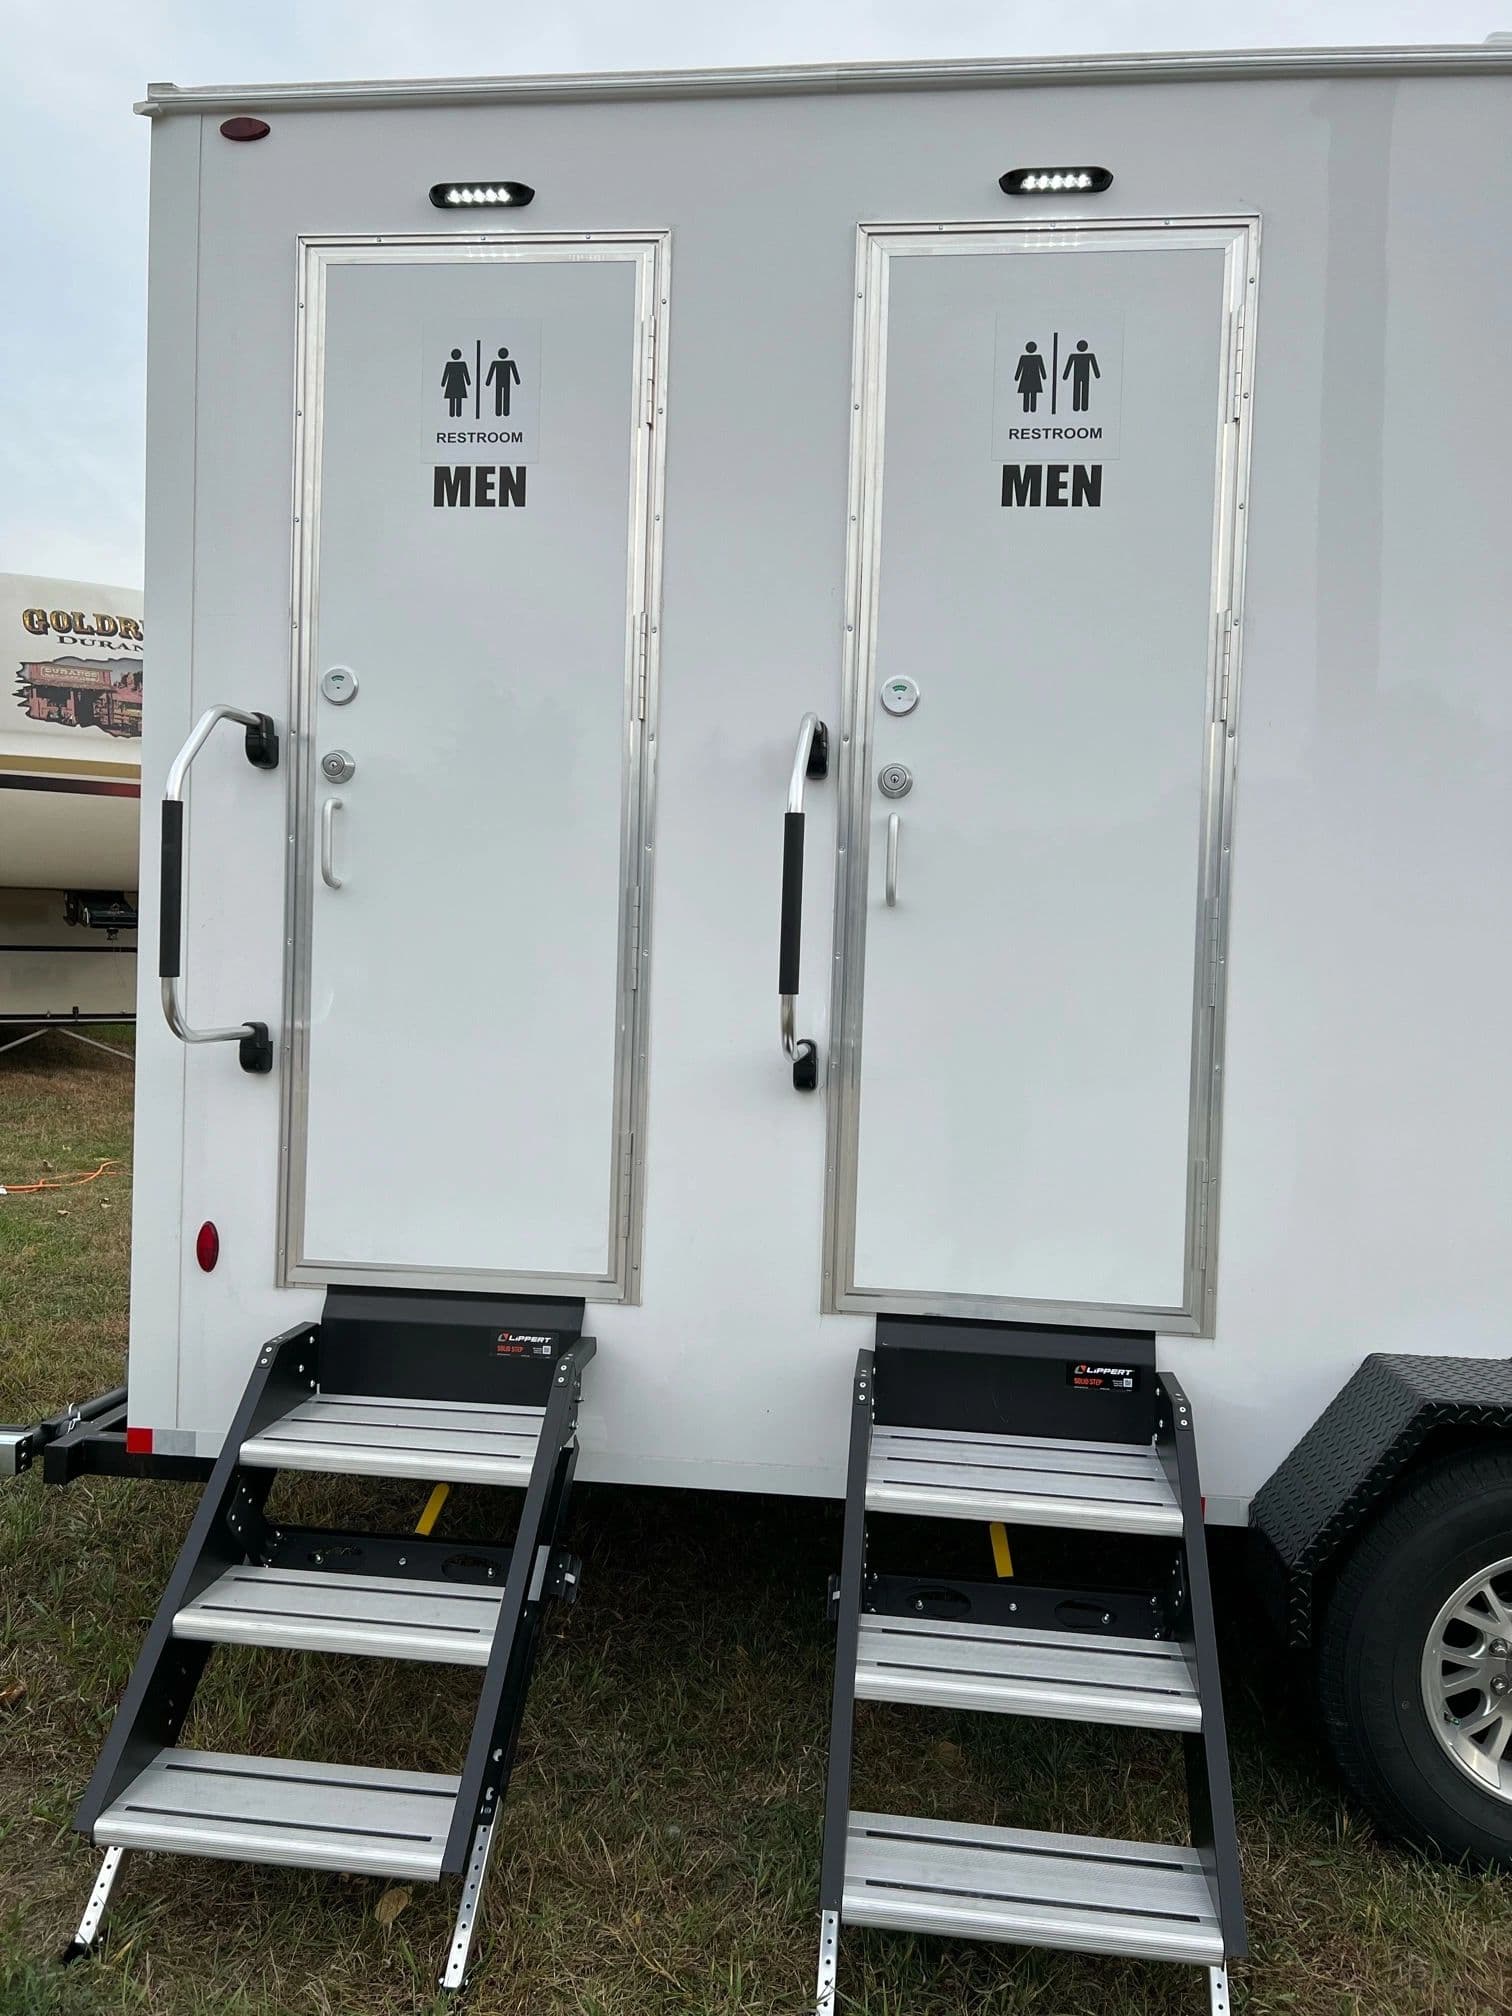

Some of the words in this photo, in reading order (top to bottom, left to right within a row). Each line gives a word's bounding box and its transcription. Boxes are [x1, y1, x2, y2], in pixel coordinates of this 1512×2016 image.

[437, 432, 523, 443] RESTROOM
[1009, 427, 1103, 440] RESTROOM
[433, 466, 527, 507] MEN
[1001, 464, 1103, 507] MEN
